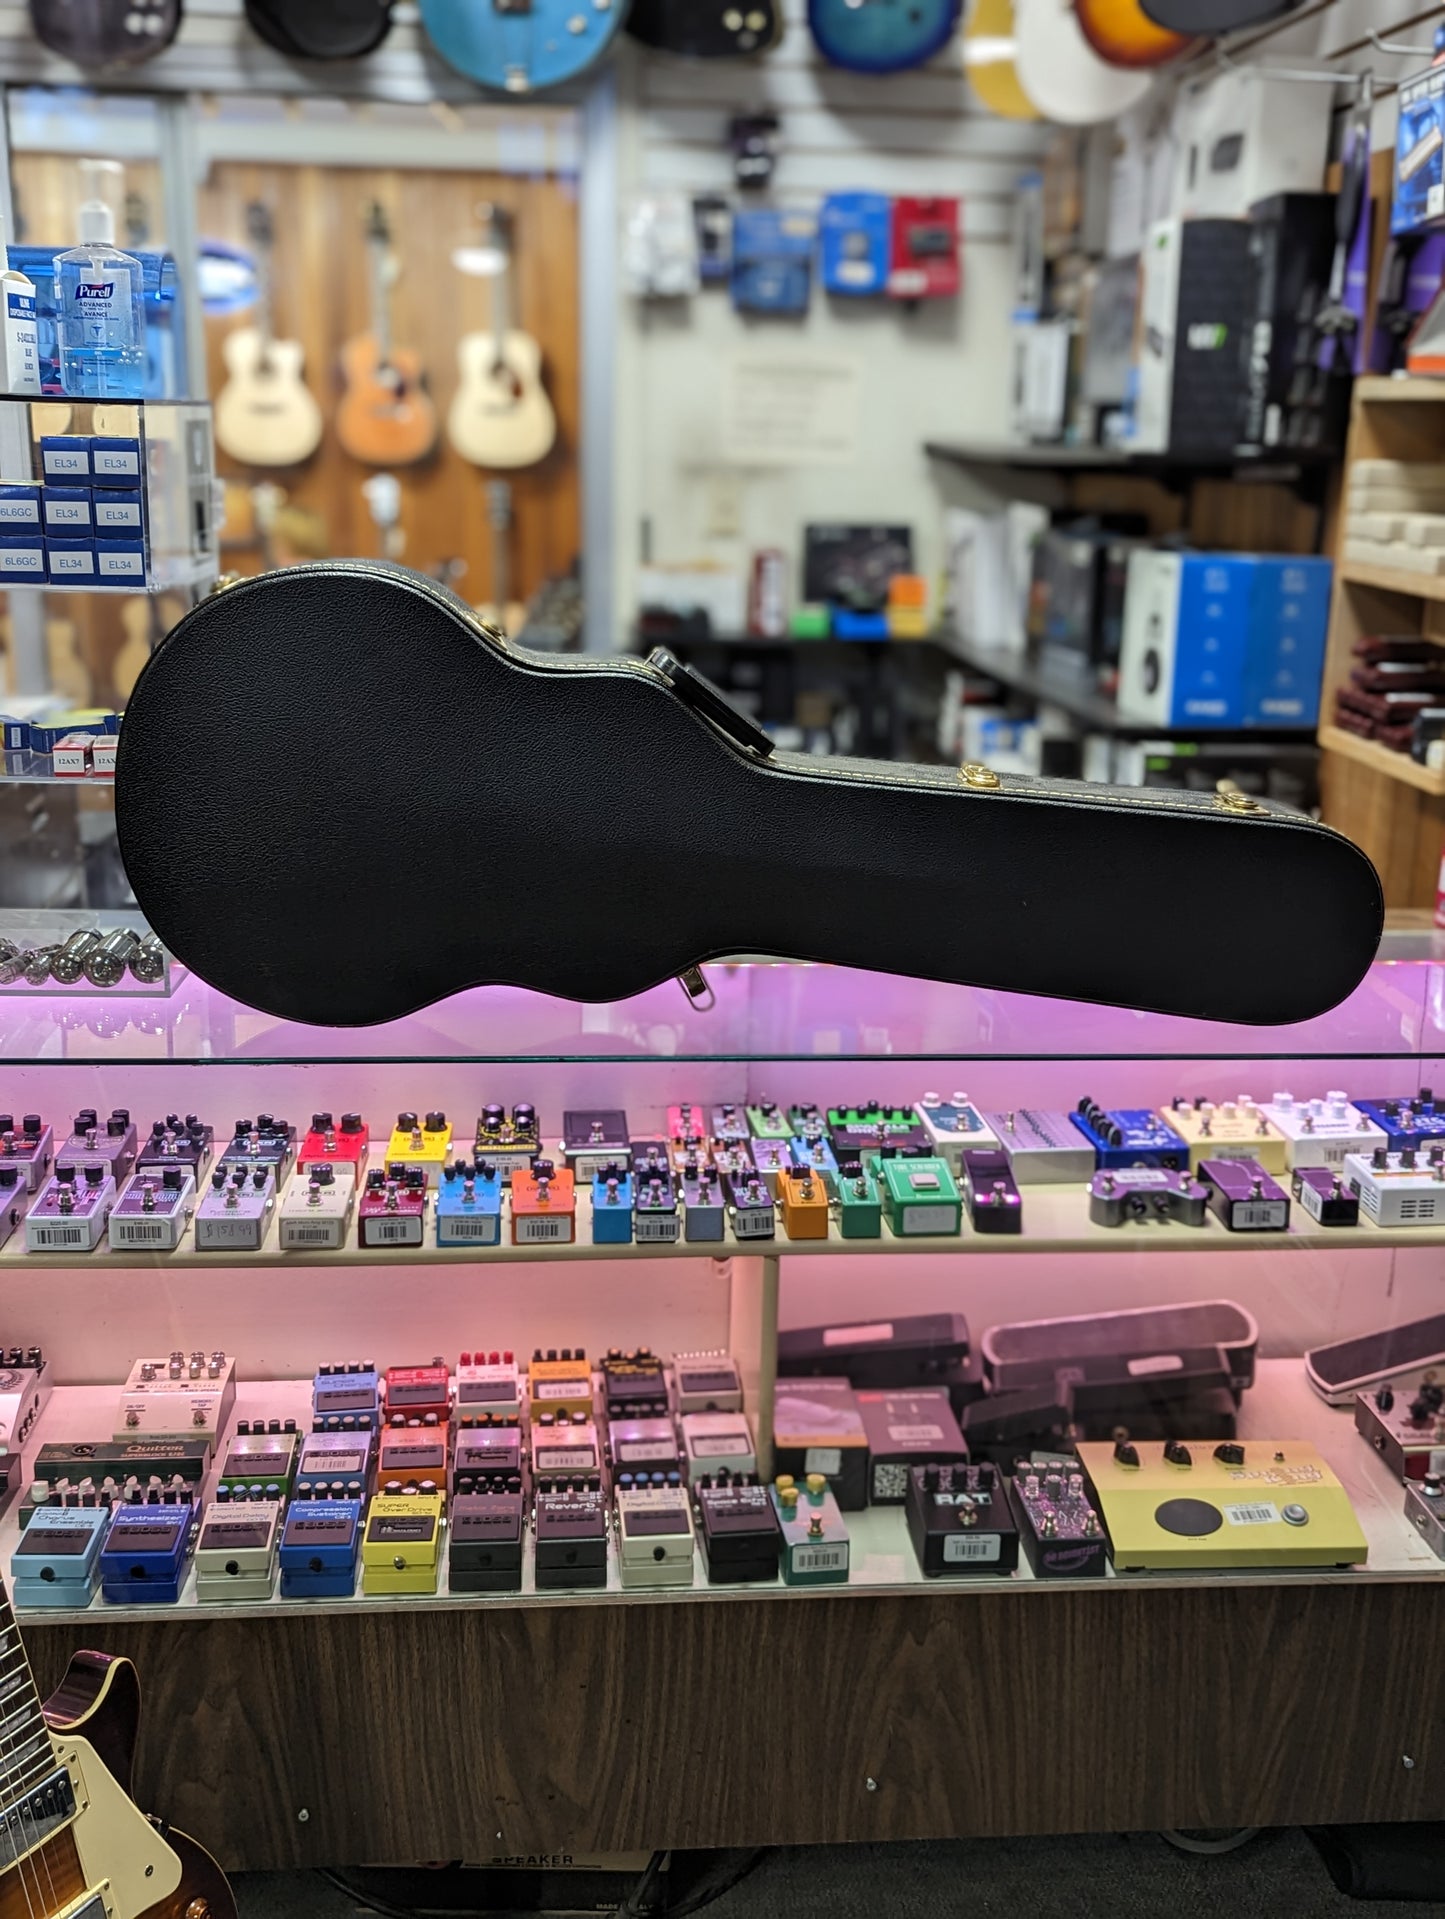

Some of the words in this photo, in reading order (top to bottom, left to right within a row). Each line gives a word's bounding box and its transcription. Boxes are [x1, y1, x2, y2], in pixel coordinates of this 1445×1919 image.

[79, 285, 111, 298] Purell
[54, 458, 78, 468] EL34
[104, 458, 128, 468] EL34
[0, 508, 32, 517] 6L6GC
[56, 509, 78, 518] EL34
[106, 510, 129, 520] EL34
[5, 557, 38, 566] 6L6GC
[60, 559, 82, 568] EL34
[108, 560, 132, 570] EL34
[936, 1493, 988, 1504] RAT
[492, 1854, 574, 1864] SPEAKER
